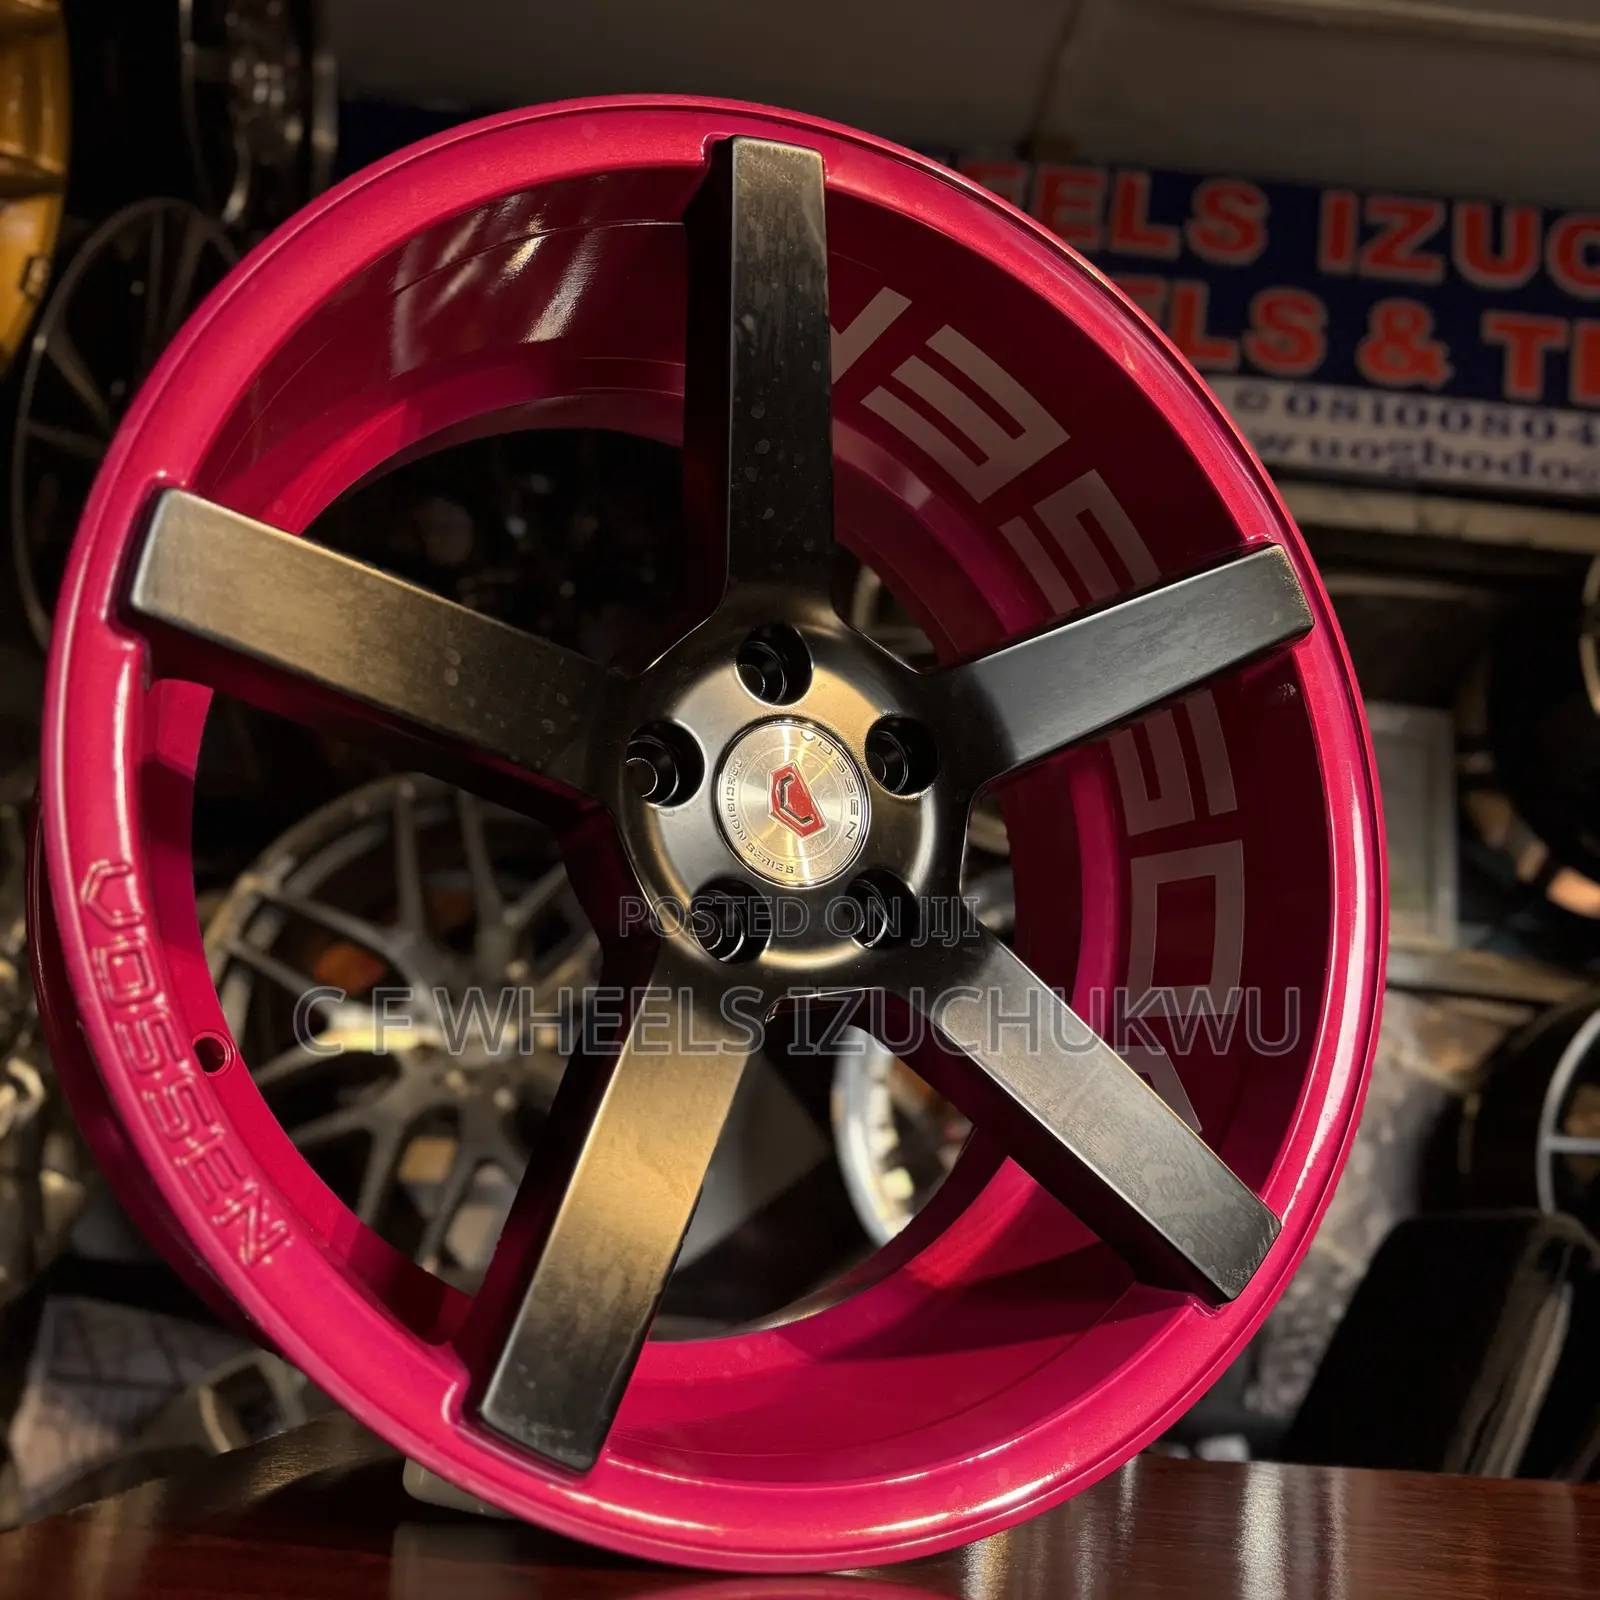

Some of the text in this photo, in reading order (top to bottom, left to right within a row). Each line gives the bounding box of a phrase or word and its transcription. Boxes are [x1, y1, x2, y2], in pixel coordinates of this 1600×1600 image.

[1355, 296, 1454, 391] &
[800, 731, 859, 841] VOSSEN
[745, 841, 795, 875] SERIES
[79, 859, 294, 1268] VOSSEN
